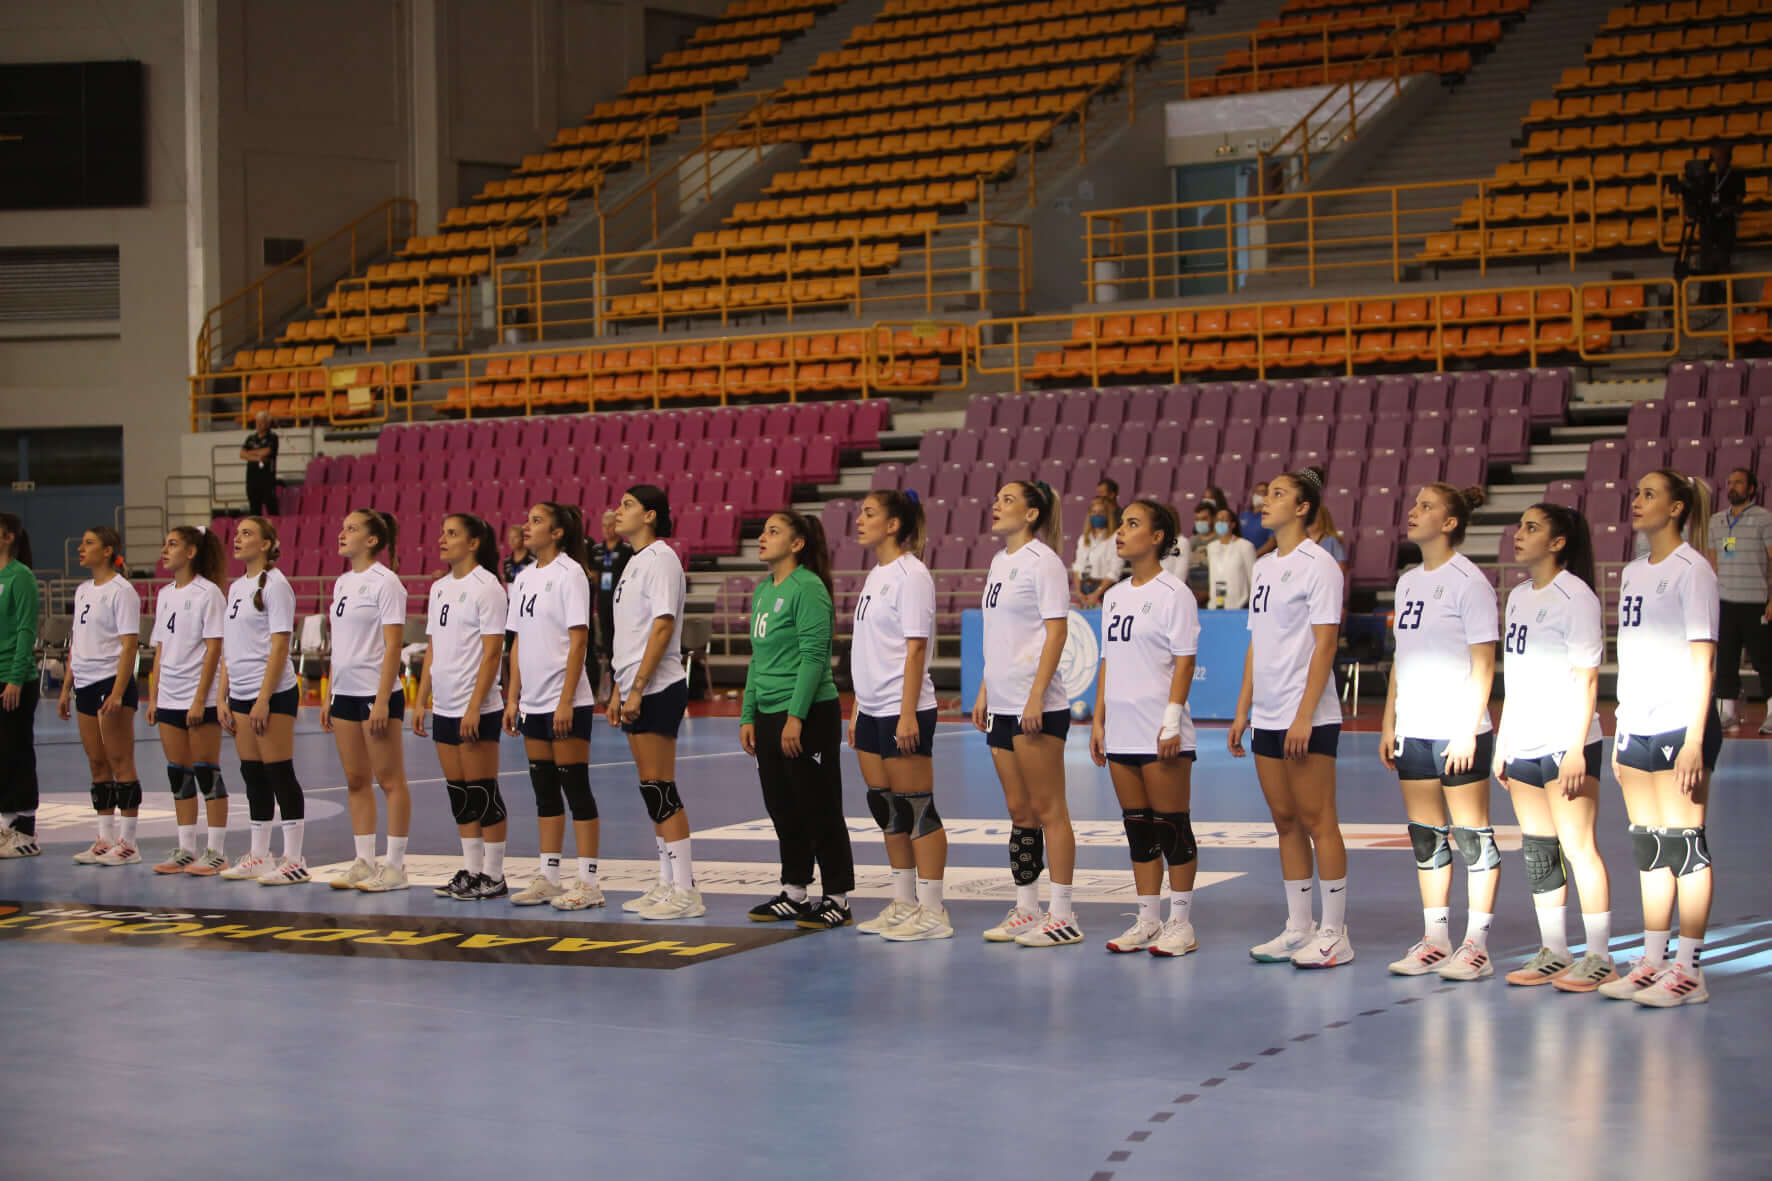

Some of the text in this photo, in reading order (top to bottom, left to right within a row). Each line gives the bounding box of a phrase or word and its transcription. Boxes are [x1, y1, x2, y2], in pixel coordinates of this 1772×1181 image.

[336, 596, 348, 617] 6
[519, 593, 537, 618] 14
[856, 595, 872, 621] 17
[985, 582, 1003, 609] 18
[1253, 585, 1271, 613] 21
[80, 604, 91, 624] 2
[229, 598, 241, 620] 5
[439, 604, 449, 627] 8
[1398, 600, 1424, 630] 23
[1623, 596, 1643, 627] 33
[167, 612, 176, 634] 4
[753, 612, 767, 638] 16
[1107, 615, 1134, 642] 20
[1506, 623, 1528, 655] 28
